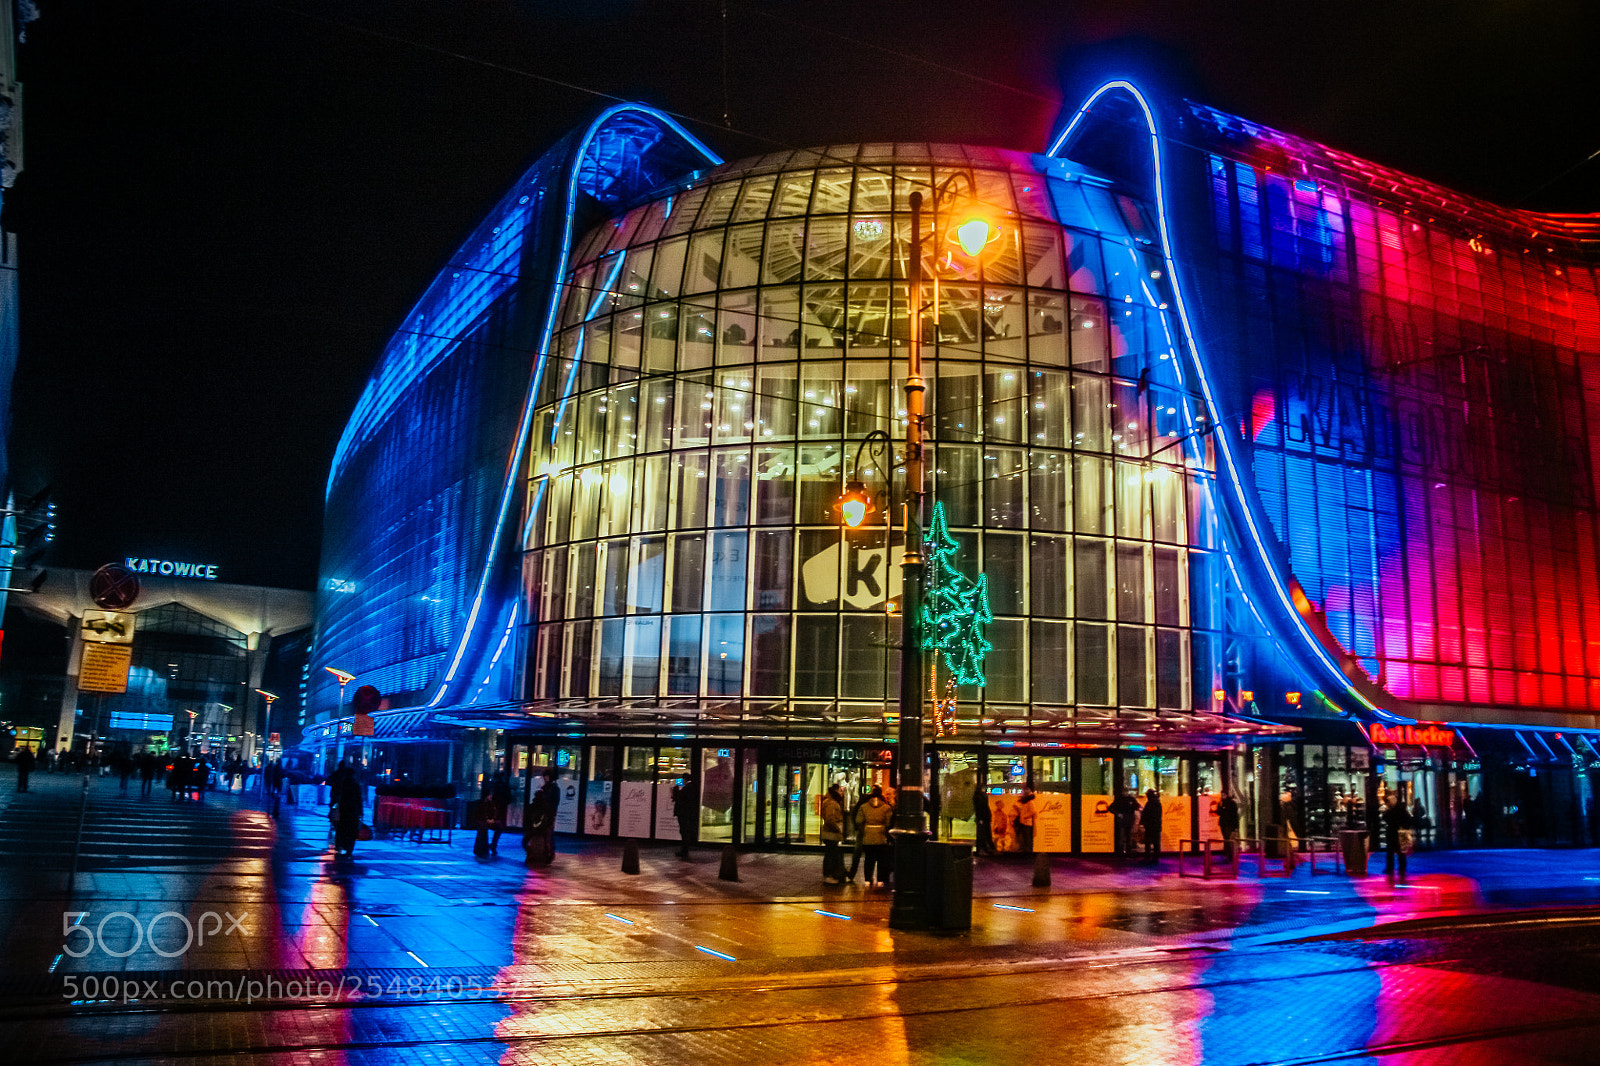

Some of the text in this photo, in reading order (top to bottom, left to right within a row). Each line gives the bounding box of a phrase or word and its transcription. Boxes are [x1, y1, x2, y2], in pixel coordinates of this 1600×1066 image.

[124, 557, 219, 580] KATOWICE
[847, 544, 882, 597] K
[1370, 722, 1454, 746] Foot Locker
